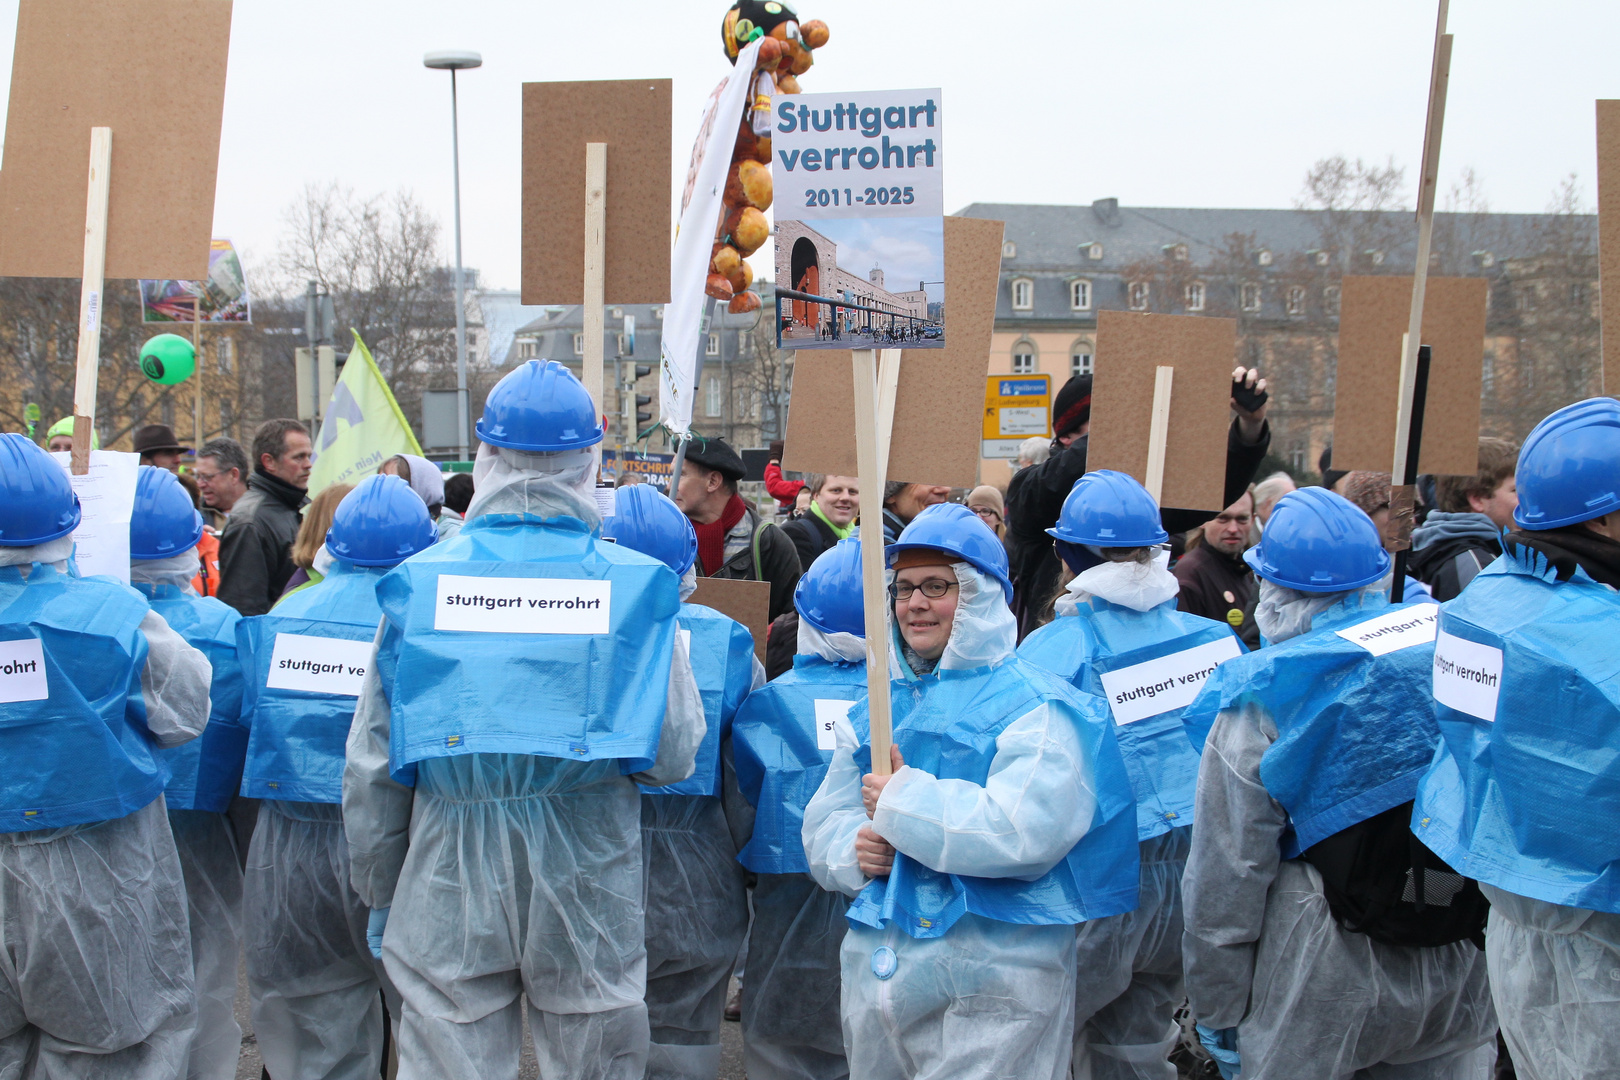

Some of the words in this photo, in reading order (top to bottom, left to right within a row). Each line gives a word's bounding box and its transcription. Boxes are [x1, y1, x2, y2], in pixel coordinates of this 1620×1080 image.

[777, 99, 937, 138] Stuttgart
[778, 135, 937, 171] verrohrt
[805, 186, 915, 207] 2011-2025
[446, 594, 522, 610] stuttgart
[528, 596, 601, 609] verrohrt
[1359, 619, 1423, 641] stuttgart
[0, 659, 37, 675] ohrt
[279, 659, 343, 675] stuttgart
[1456, 665, 1497, 687] verrohrt
[1116, 677, 1175, 704] stuttgart
